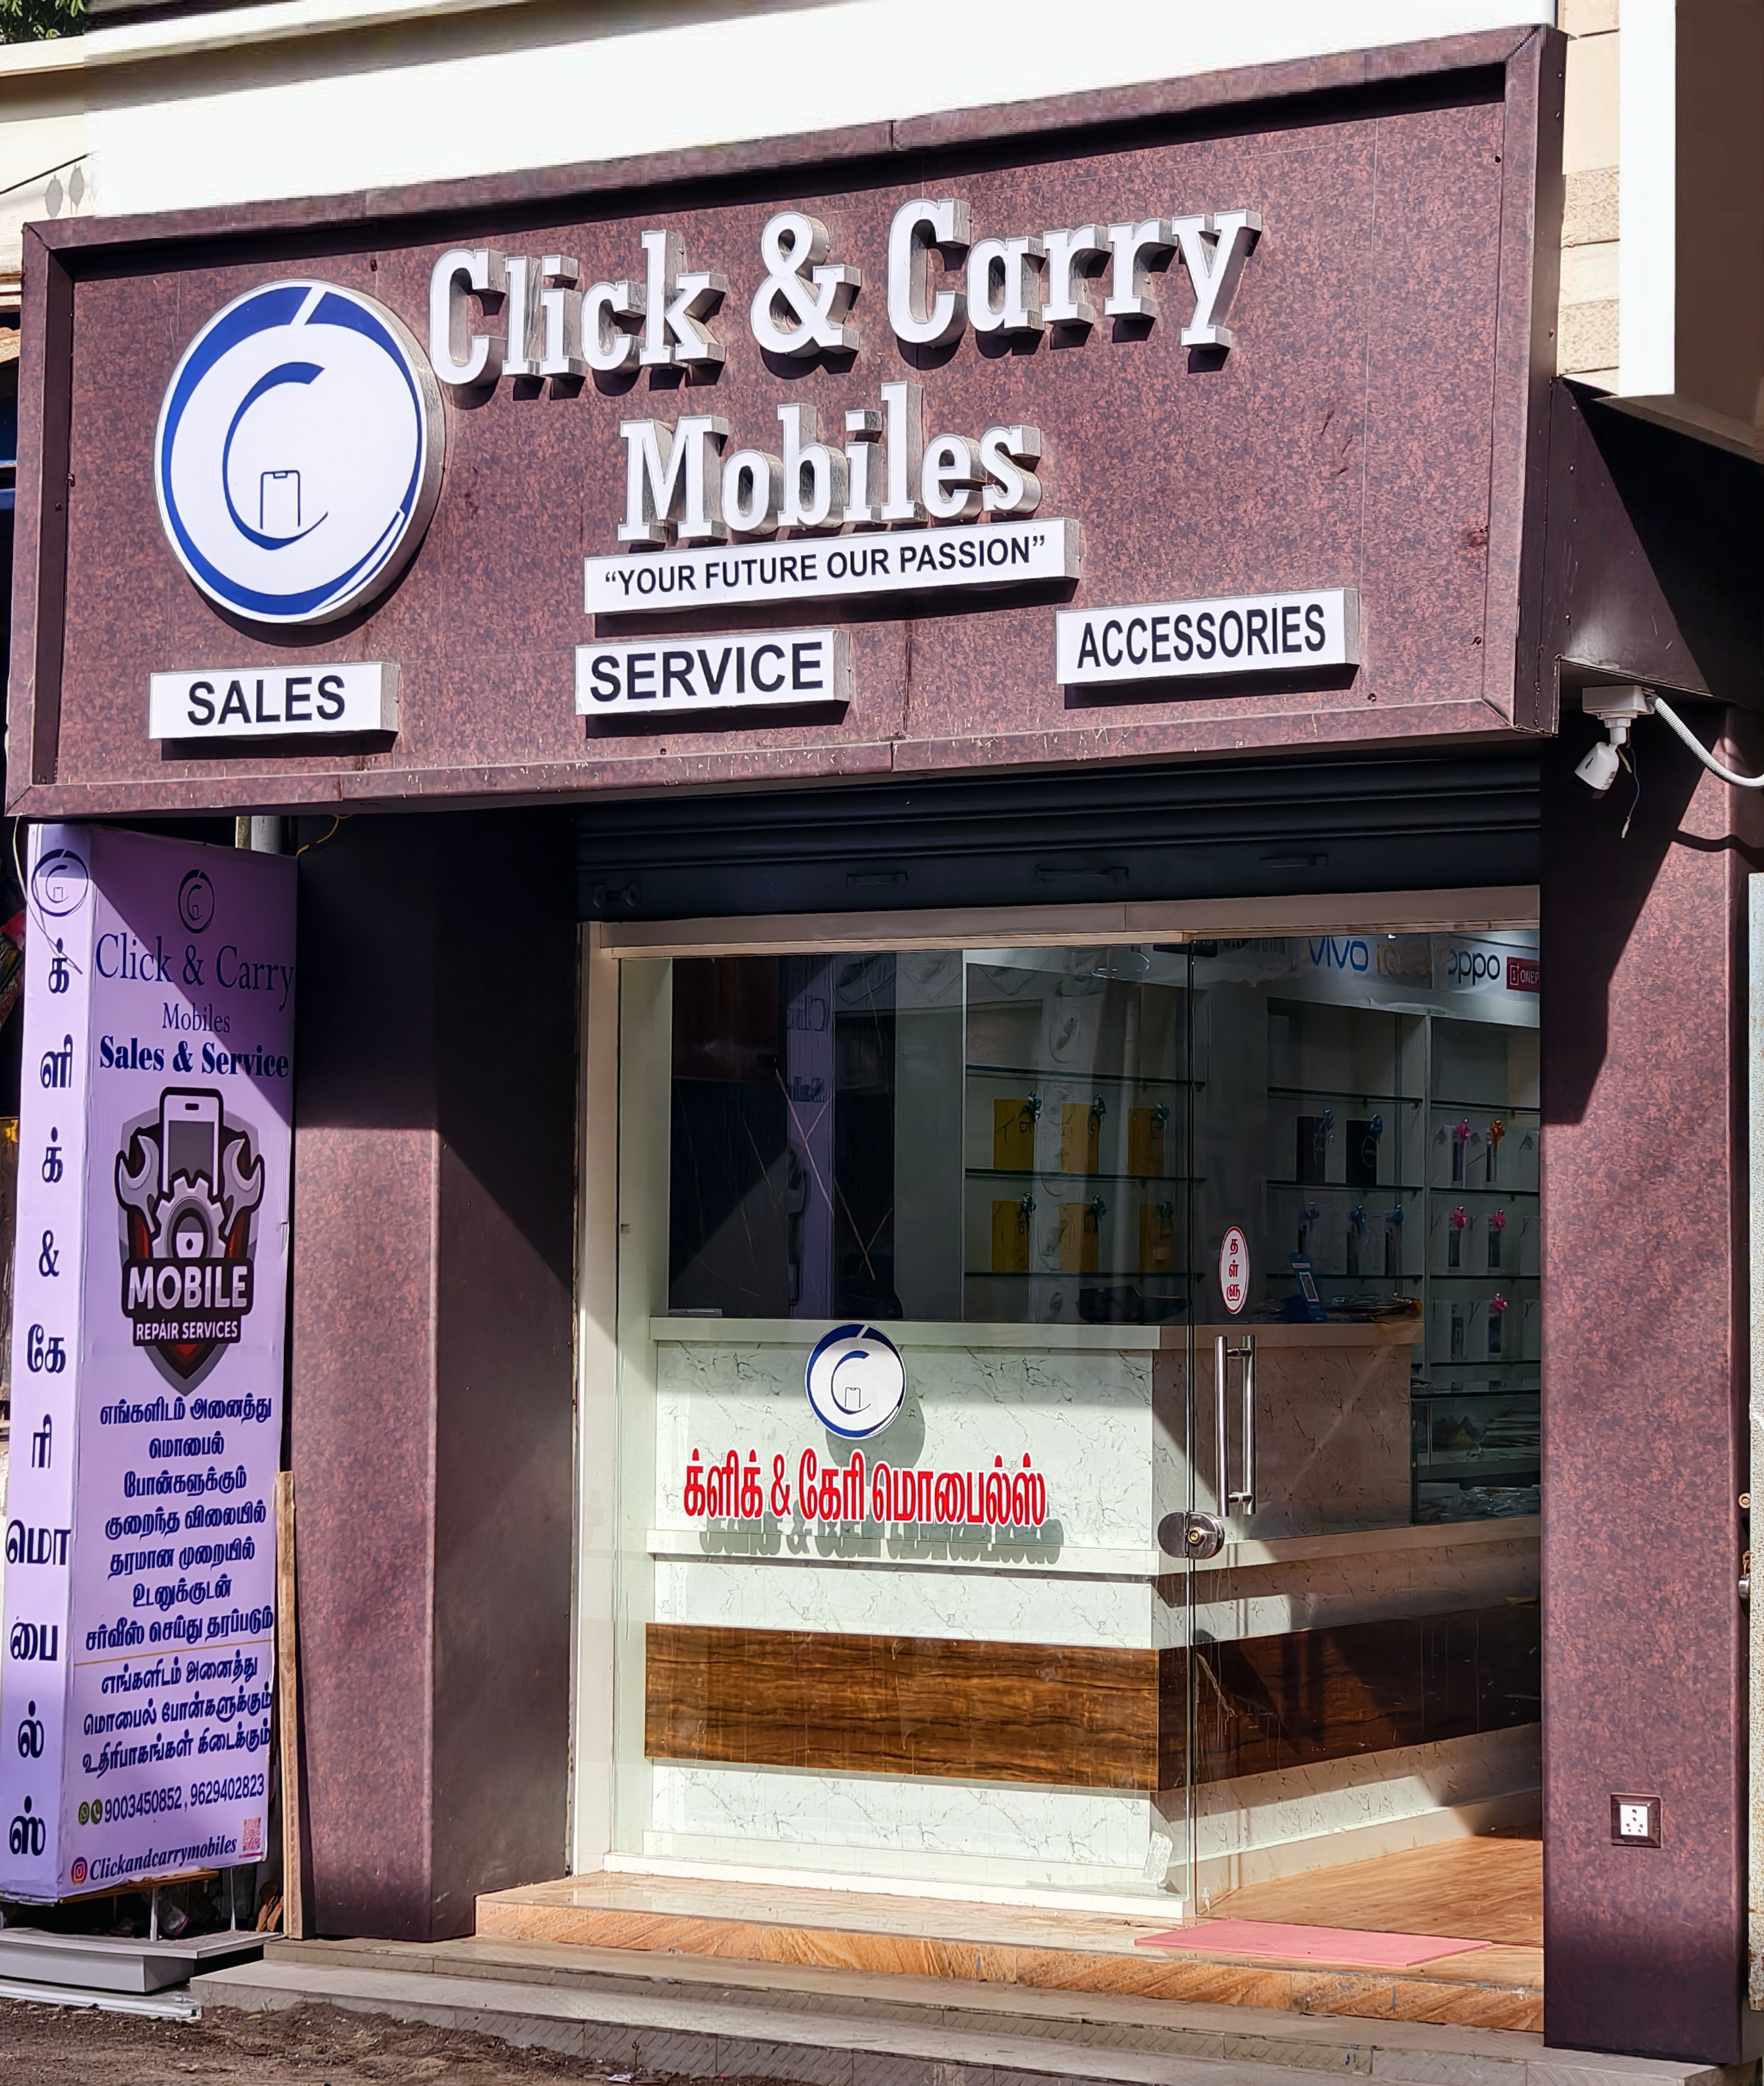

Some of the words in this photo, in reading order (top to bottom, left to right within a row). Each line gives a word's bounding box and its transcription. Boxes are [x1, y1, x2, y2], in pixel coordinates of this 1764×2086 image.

[429, 229, 713, 385] Click
[751, 211, 846, 353] &
[888, 198, 1249, 348] Carry
[618, 381, 1031, 542] Mobiles
[705, 554, 817, 589] FUTURE
[827, 547, 890, 579] OUR
[1077, 603, 1326, 669] ACCESSORIES
[589, 642, 823, 703] SERVICE
[187, 674, 345, 726] SALES
[96, 932, 174, 983] Click
[182, 944, 205, 986] &
[216, 945, 295, 1011] Carry
[162, 1003, 231, 1033] Mobiles
[99, 1035, 164, 1072] Sales
[173, 1040, 193, 1073] &
[201, 1041, 290, 1078] Service
[38, 1230, 60, 1277] &
[127, 1265, 248, 1310] MOBILE
[136, 1319, 178, 1341] REPAIR
[182, 1320, 238, 1339] SERVICES
[99, 1396, 186, 1425] எங்களிடம்
[189, 1392, 272, 1426] அனைத்து
[149, 1430, 225, 1459] மொபைல்
[124, 1464, 247, 1498] போன்களுக்கும்
[770, 1451, 793, 1518] &
[798, 1446, 866, 1523] கேரி
[105, 1506, 181, 1542] குறைந்த
[184, 1499, 267, 1529] விலையில்
[107, 1548, 175, 1582] தரமான
[178, 1535, 255, 1572] முறையில்
[132, 1573, 233, 1612] உடனுக்குடன்
[149, 1614, 203, 1644] செய்து
[205, 1605, 274, 1643] தரப்படும்
[101, 1656, 182, 1694] எங்களிடம்
[186, 1648, 258, 1684] அனைத்து
[83, 1697, 157, 1736] மொபைல்
[161, 1681, 272, 1723] போன்களுக்கும்
[82, 1728, 194, 1779] உதிரிபாகங்கள்
[197, 1717, 271, 1755] கிடைக்கும்
[190, 1772, 265, 1807] 9629402823
[89, 1834, 238, 1881] Clickandcarrymobiles
